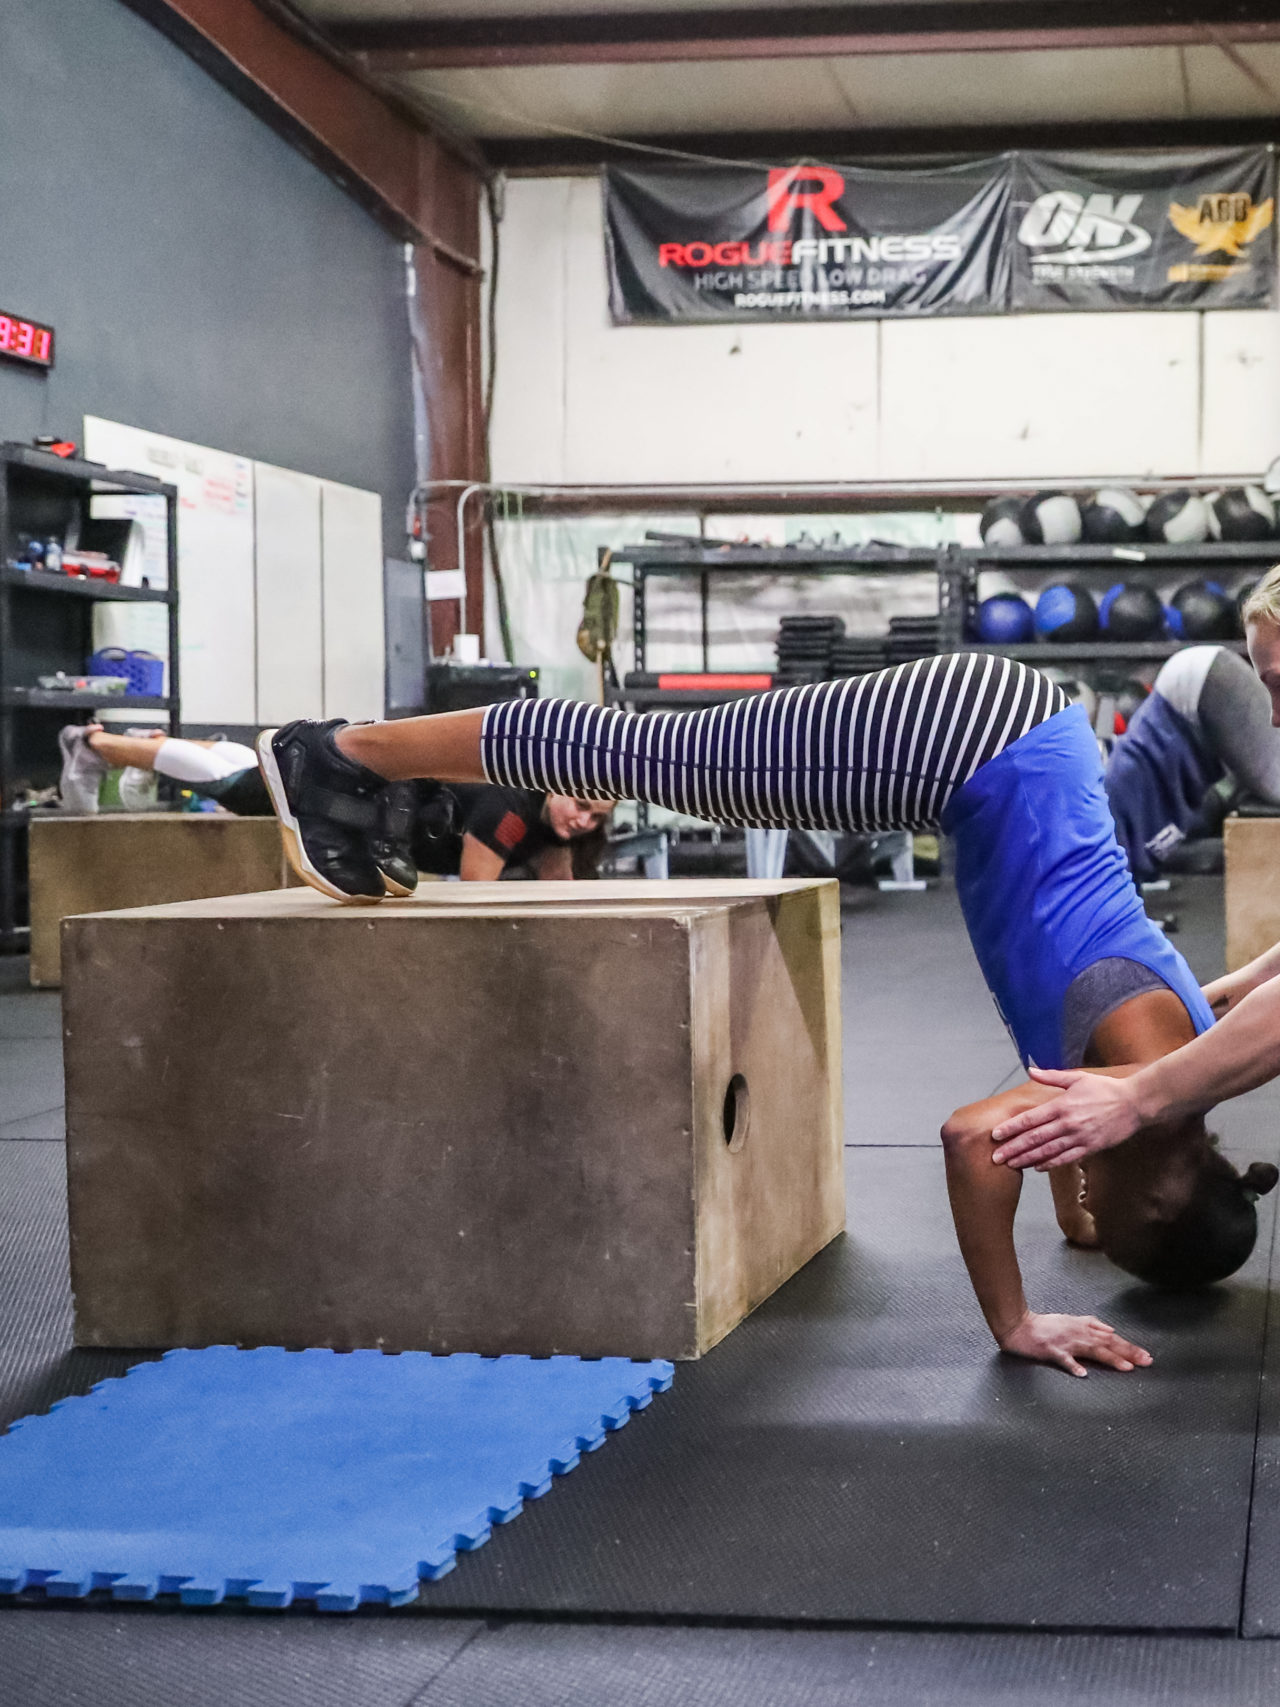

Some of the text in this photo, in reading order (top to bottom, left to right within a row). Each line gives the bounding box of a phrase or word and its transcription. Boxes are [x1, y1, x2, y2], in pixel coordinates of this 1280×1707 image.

[767, 165, 846, 231] R
[1018, 191, 1147, 248] ON
[693, 270, 743, 290] HIGH
[867, 266, 927, 287] DRAG
